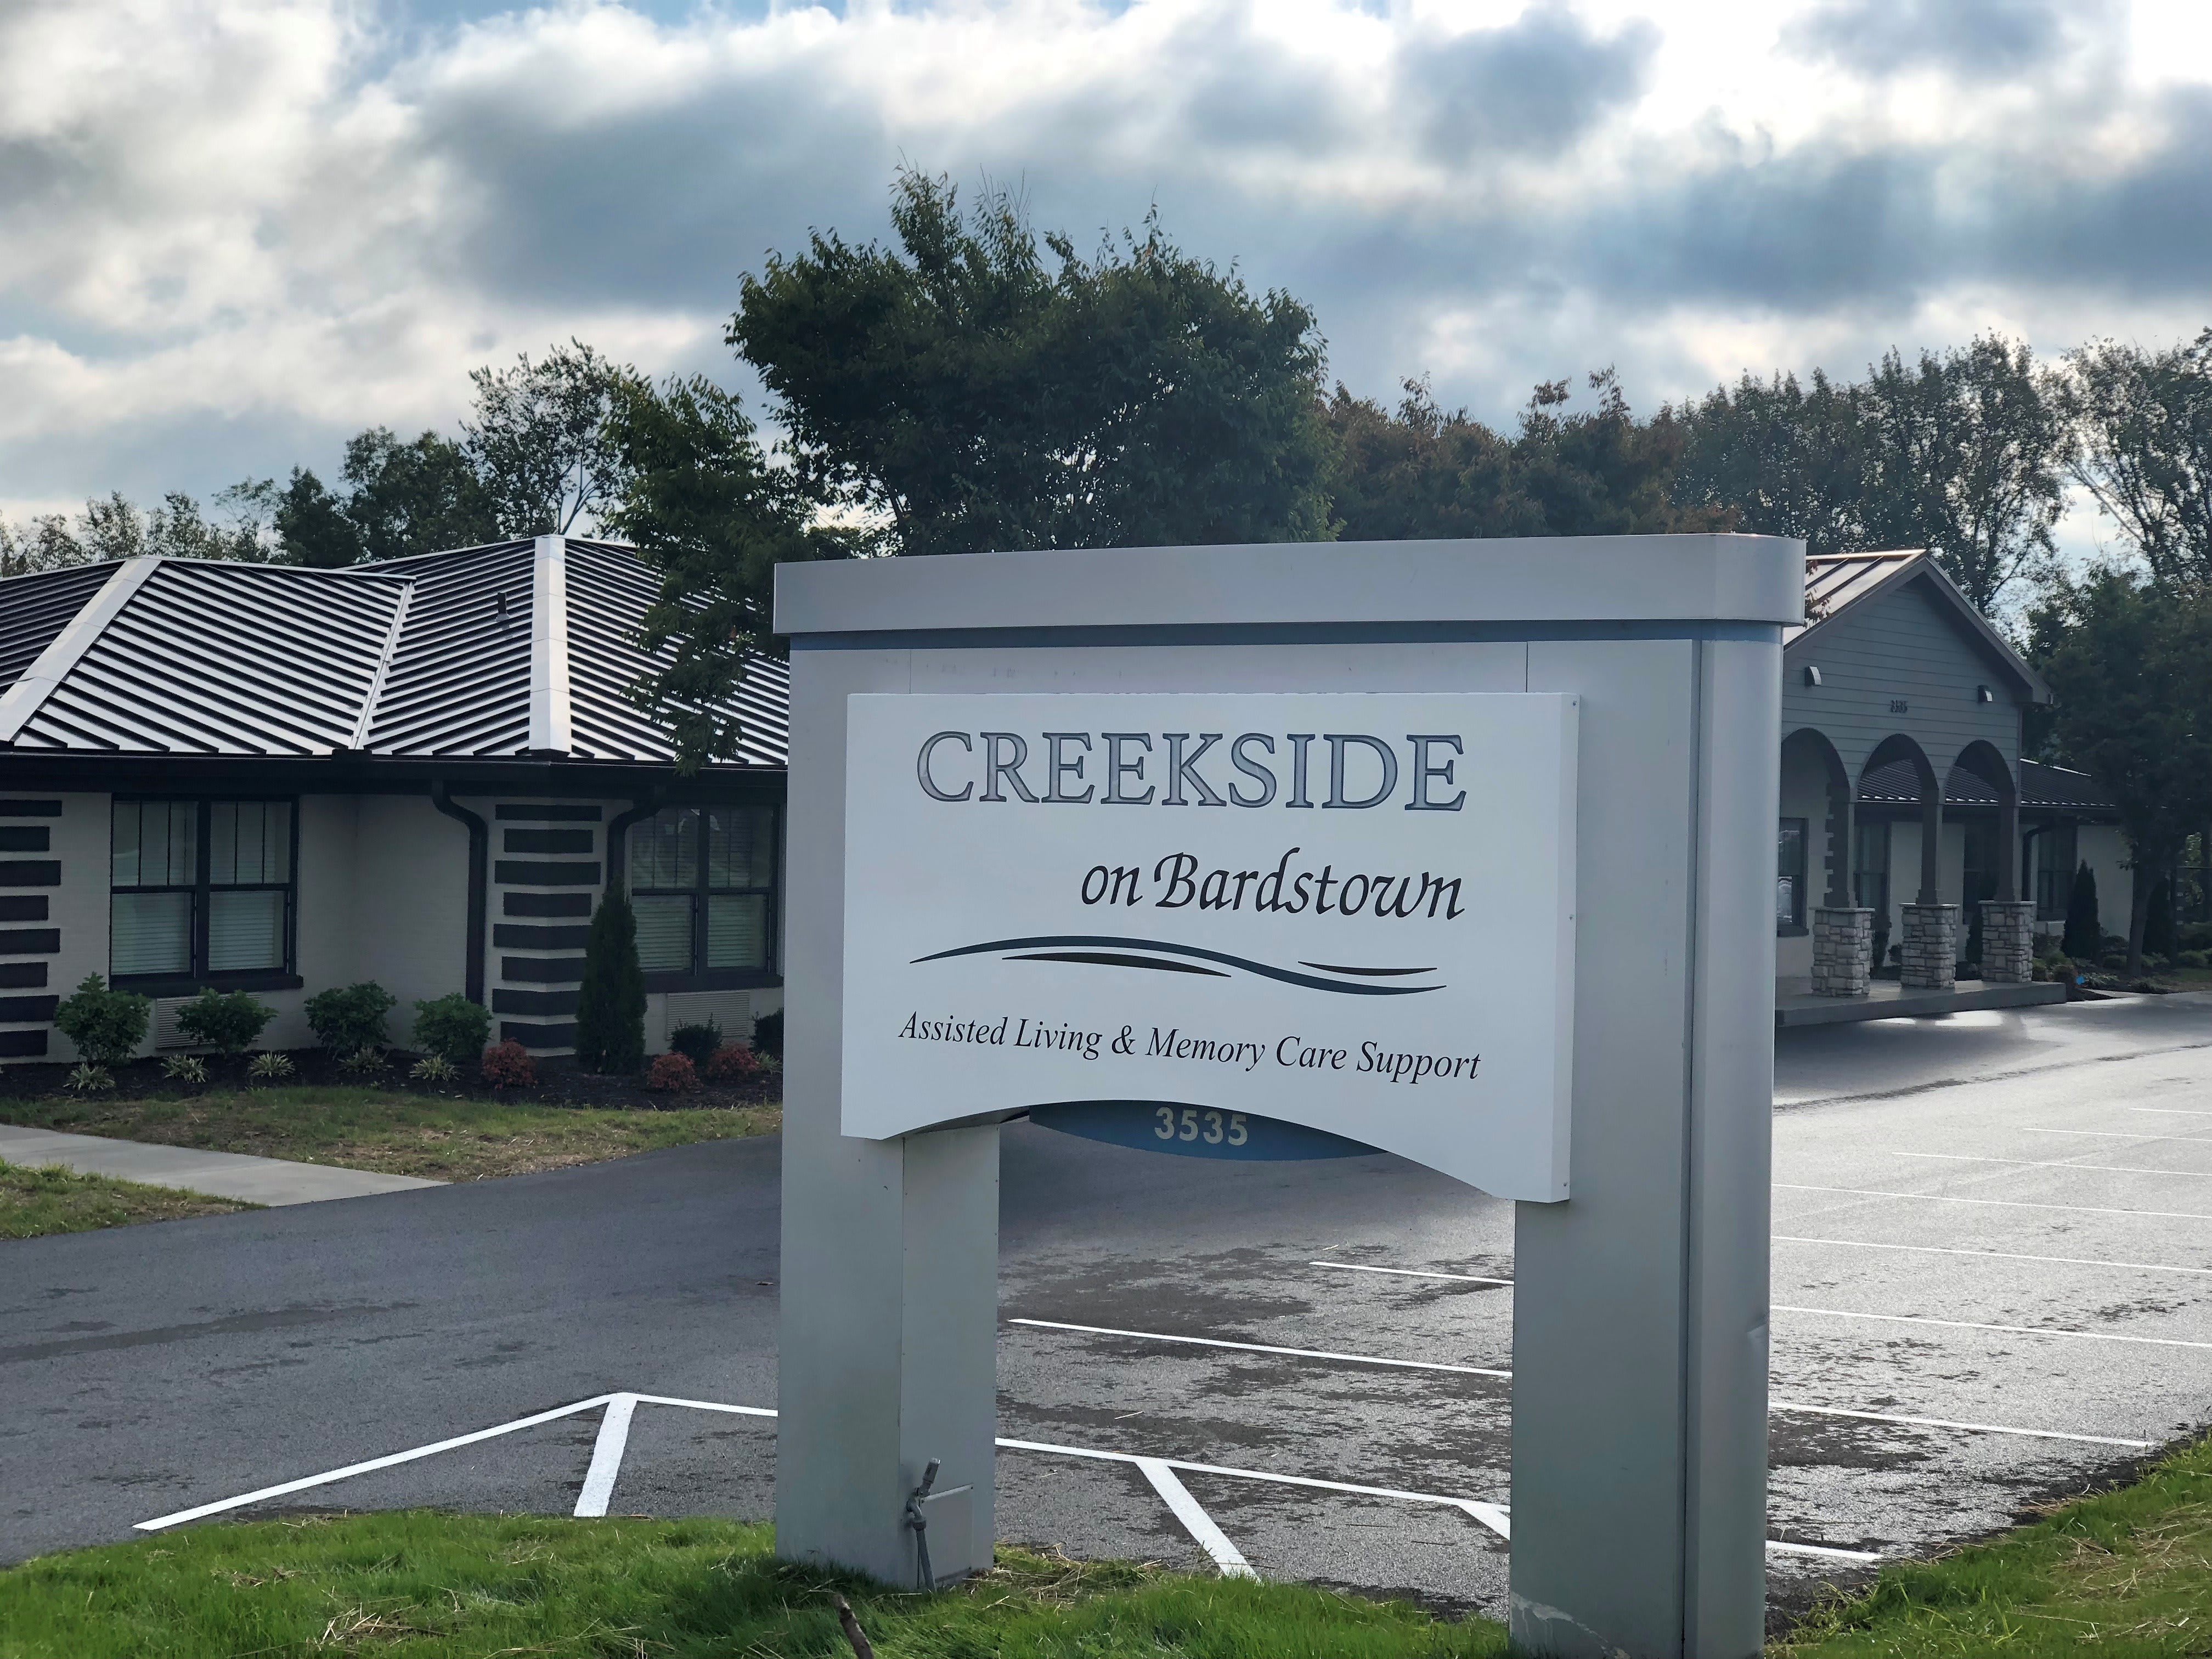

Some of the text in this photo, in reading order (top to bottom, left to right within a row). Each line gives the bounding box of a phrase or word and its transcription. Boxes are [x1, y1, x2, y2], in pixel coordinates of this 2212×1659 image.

[916, 731, 1468, 812] CREEKSIDE
[1081, 847, 1466, 921] on Bardstown
[898, 1011, 1481, 1085] Assisted Living & Memory Care Support
[1154, 1107, 1249, 1146] 3535
